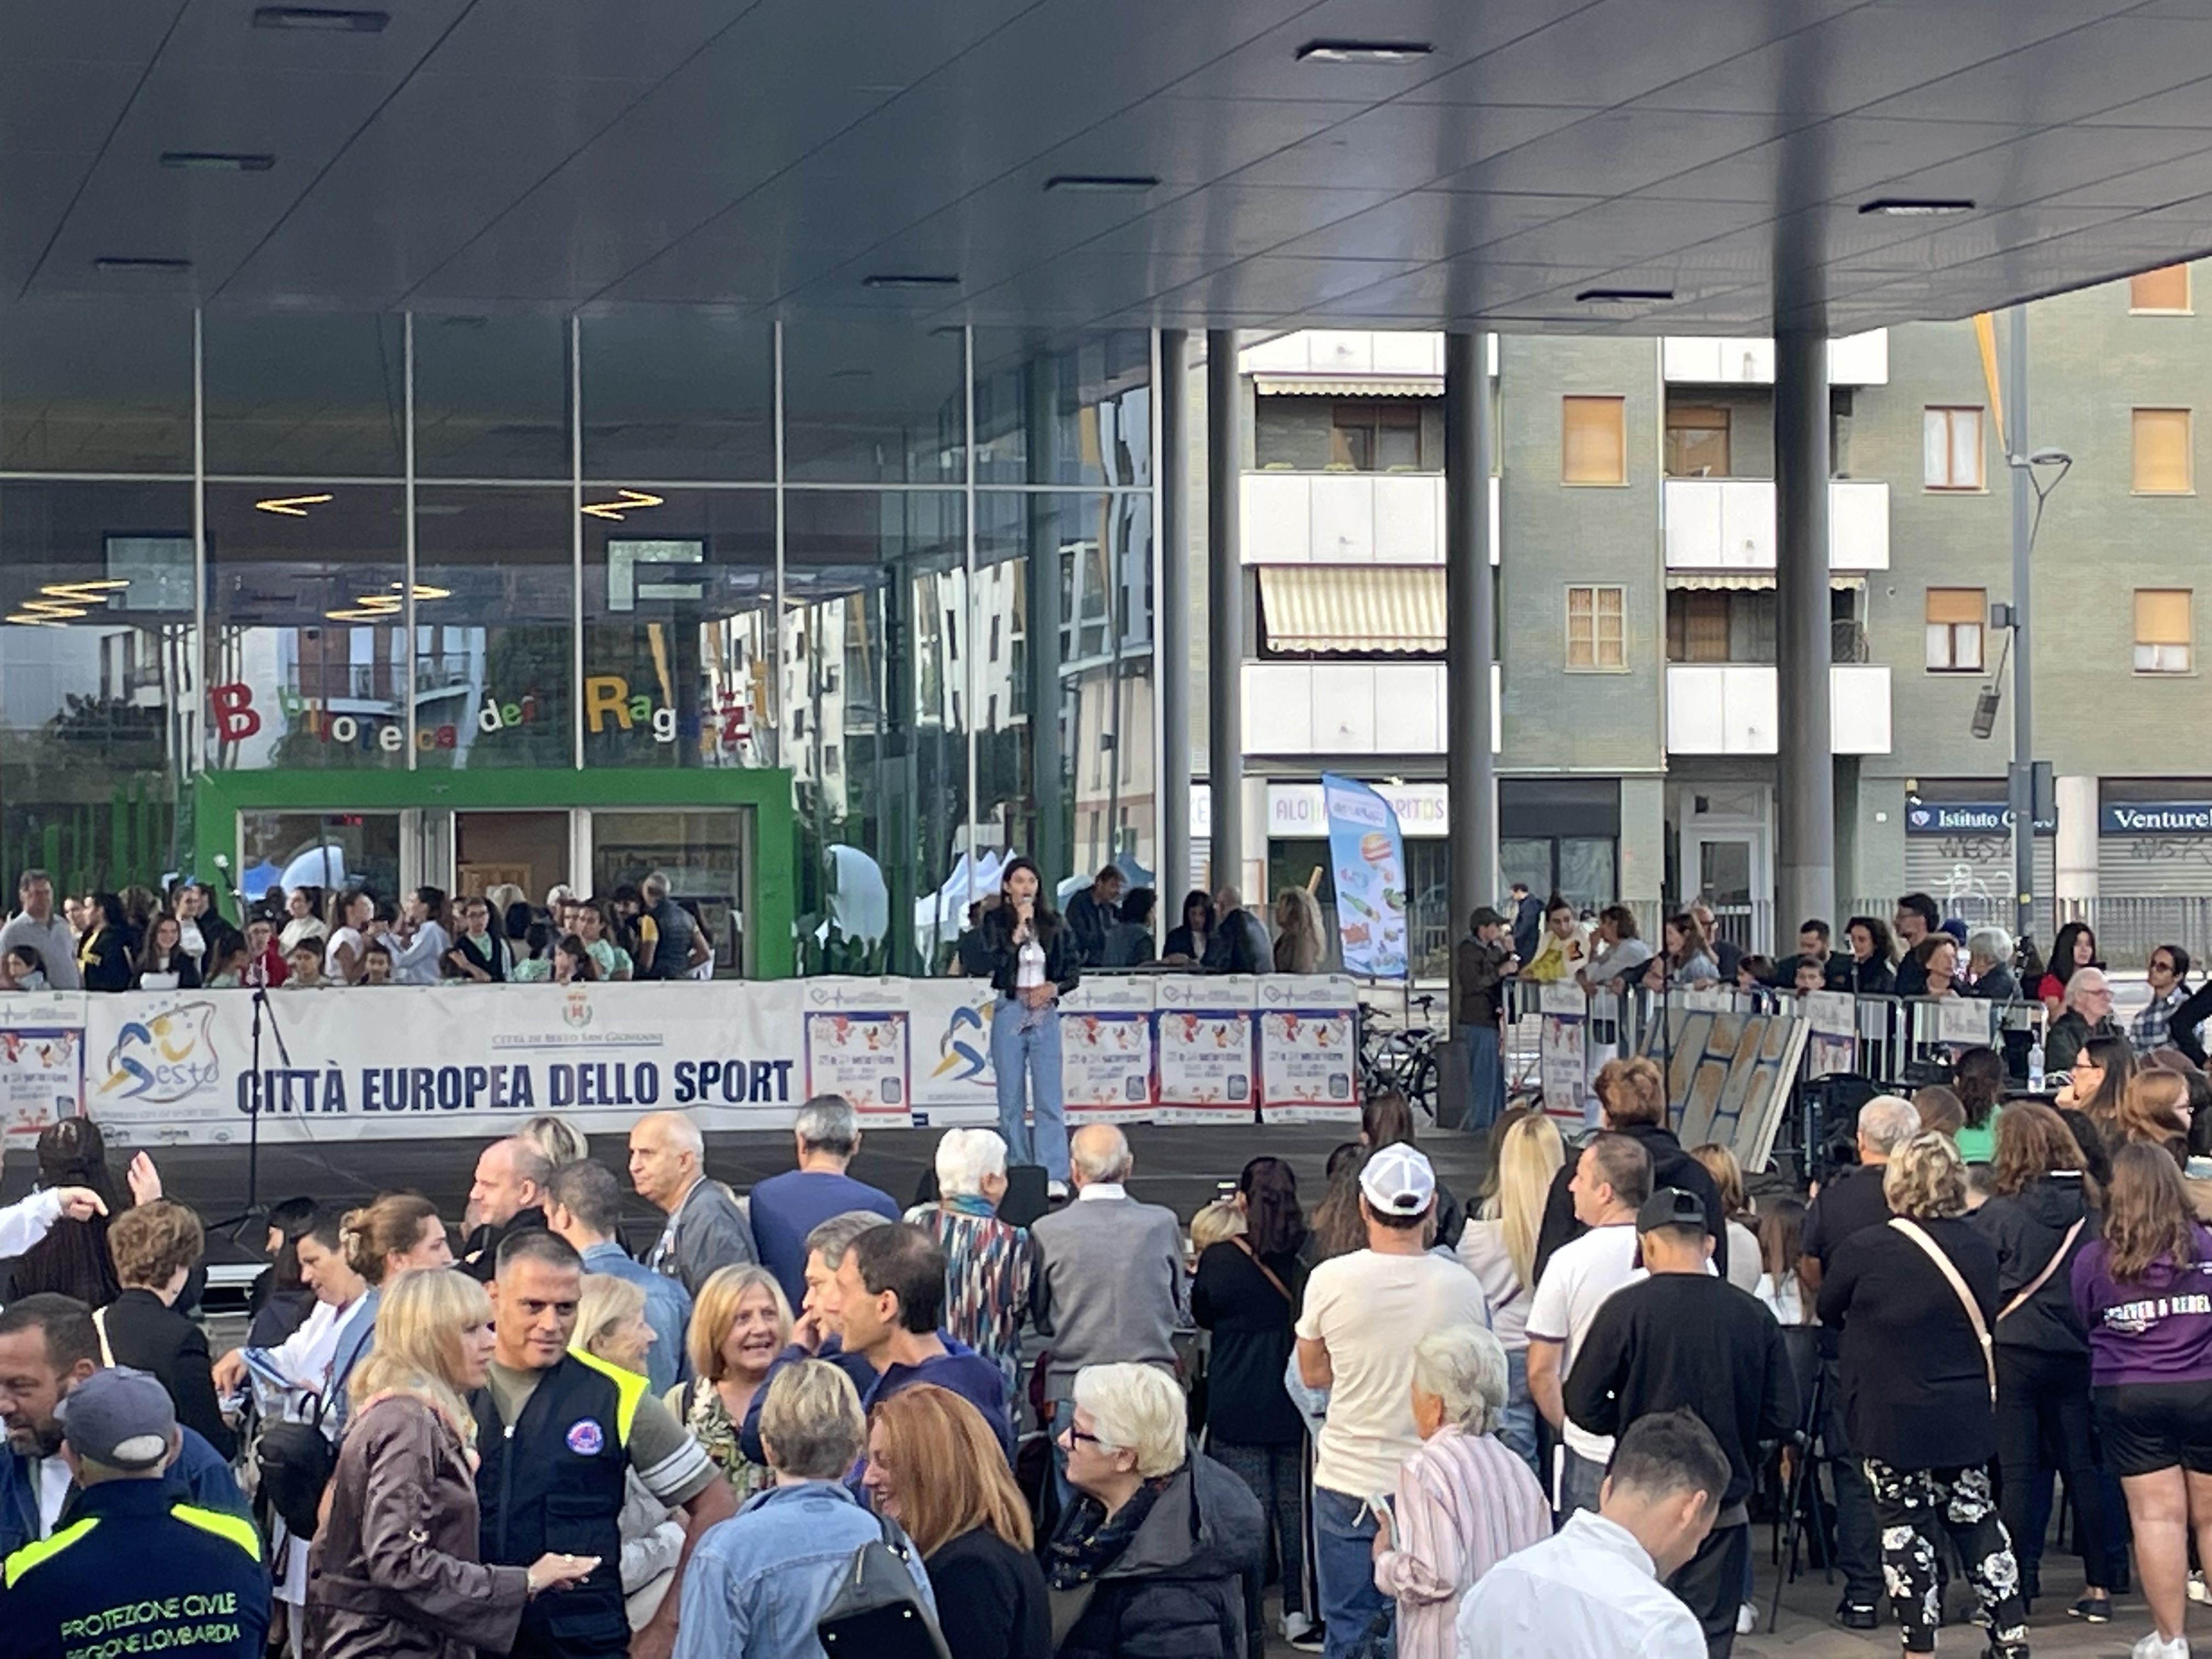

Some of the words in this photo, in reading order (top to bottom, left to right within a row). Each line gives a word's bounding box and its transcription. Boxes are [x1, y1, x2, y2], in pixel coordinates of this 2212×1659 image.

[210, 682, 456, 752] Bblioteca
[478, 696, 535, 733] dei
[585, 676, 769, 753] Ragzi
[1276, 799, 1327, 821] ALOH
[1389, 798, 1444, 821] RITOS
[1938, 810, 1999, 828] Istituto
[236, 1059, 348, 1114] CITTÀ
[362, 1063, 534, 1112] EUROPEA
[549, 1061, 659, 1108] DELLO
[674, 1059, 794, 1103] SPORT
[60, 1597, 180, 1641] PROTEZIONE
[183, 1592, 238, 1617] CIVILE
[142, 1623, 241, 1651] LOMBARDIA
